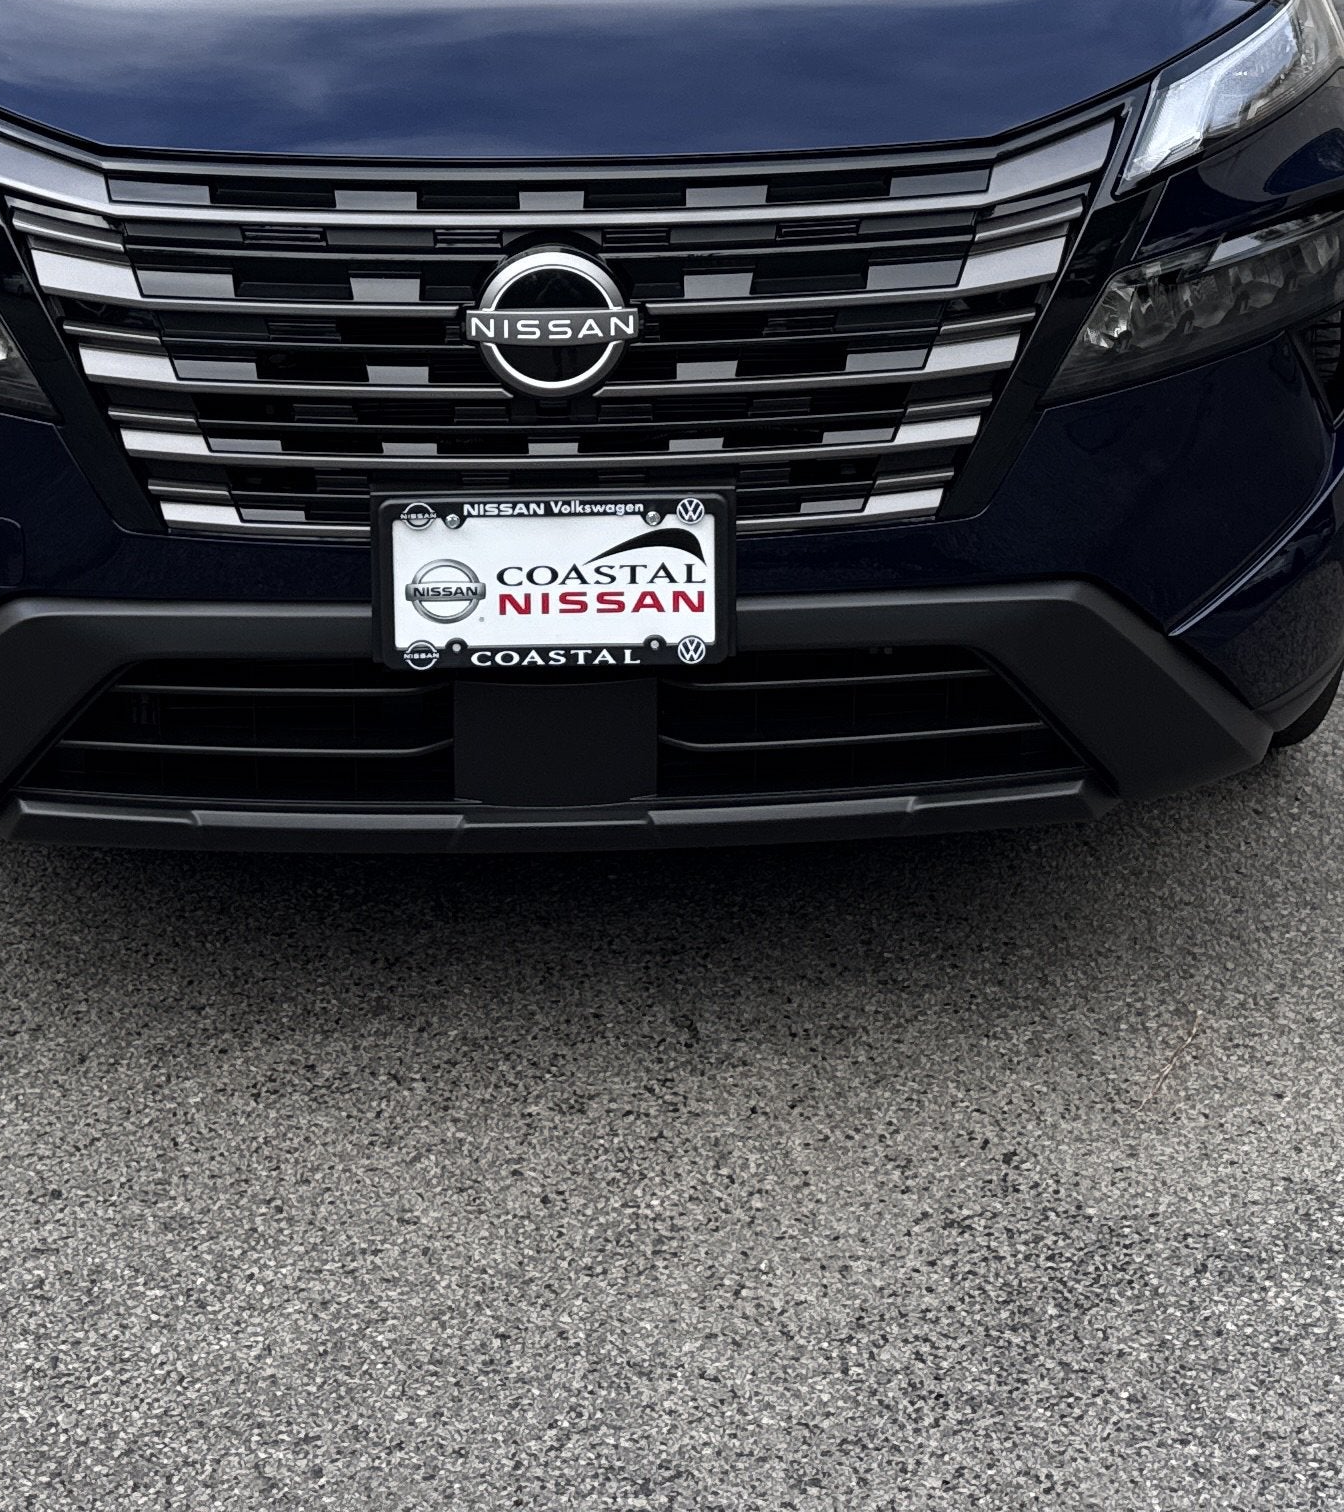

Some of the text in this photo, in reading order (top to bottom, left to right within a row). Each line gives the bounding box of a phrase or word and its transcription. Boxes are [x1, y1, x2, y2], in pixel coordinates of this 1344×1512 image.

[471, 315, 634, 339] NISSAN
[400, 512, 437, 520] NISSAN
[463, 500, 644, 516] NISSAN Volkswagen
[496, 562, 707, 586] COASTAL
[413, 586, 478, 597] NISSAN
[499, 591, 705, 615] NISSAN
[470, 648, 641, 666] COASTAL
